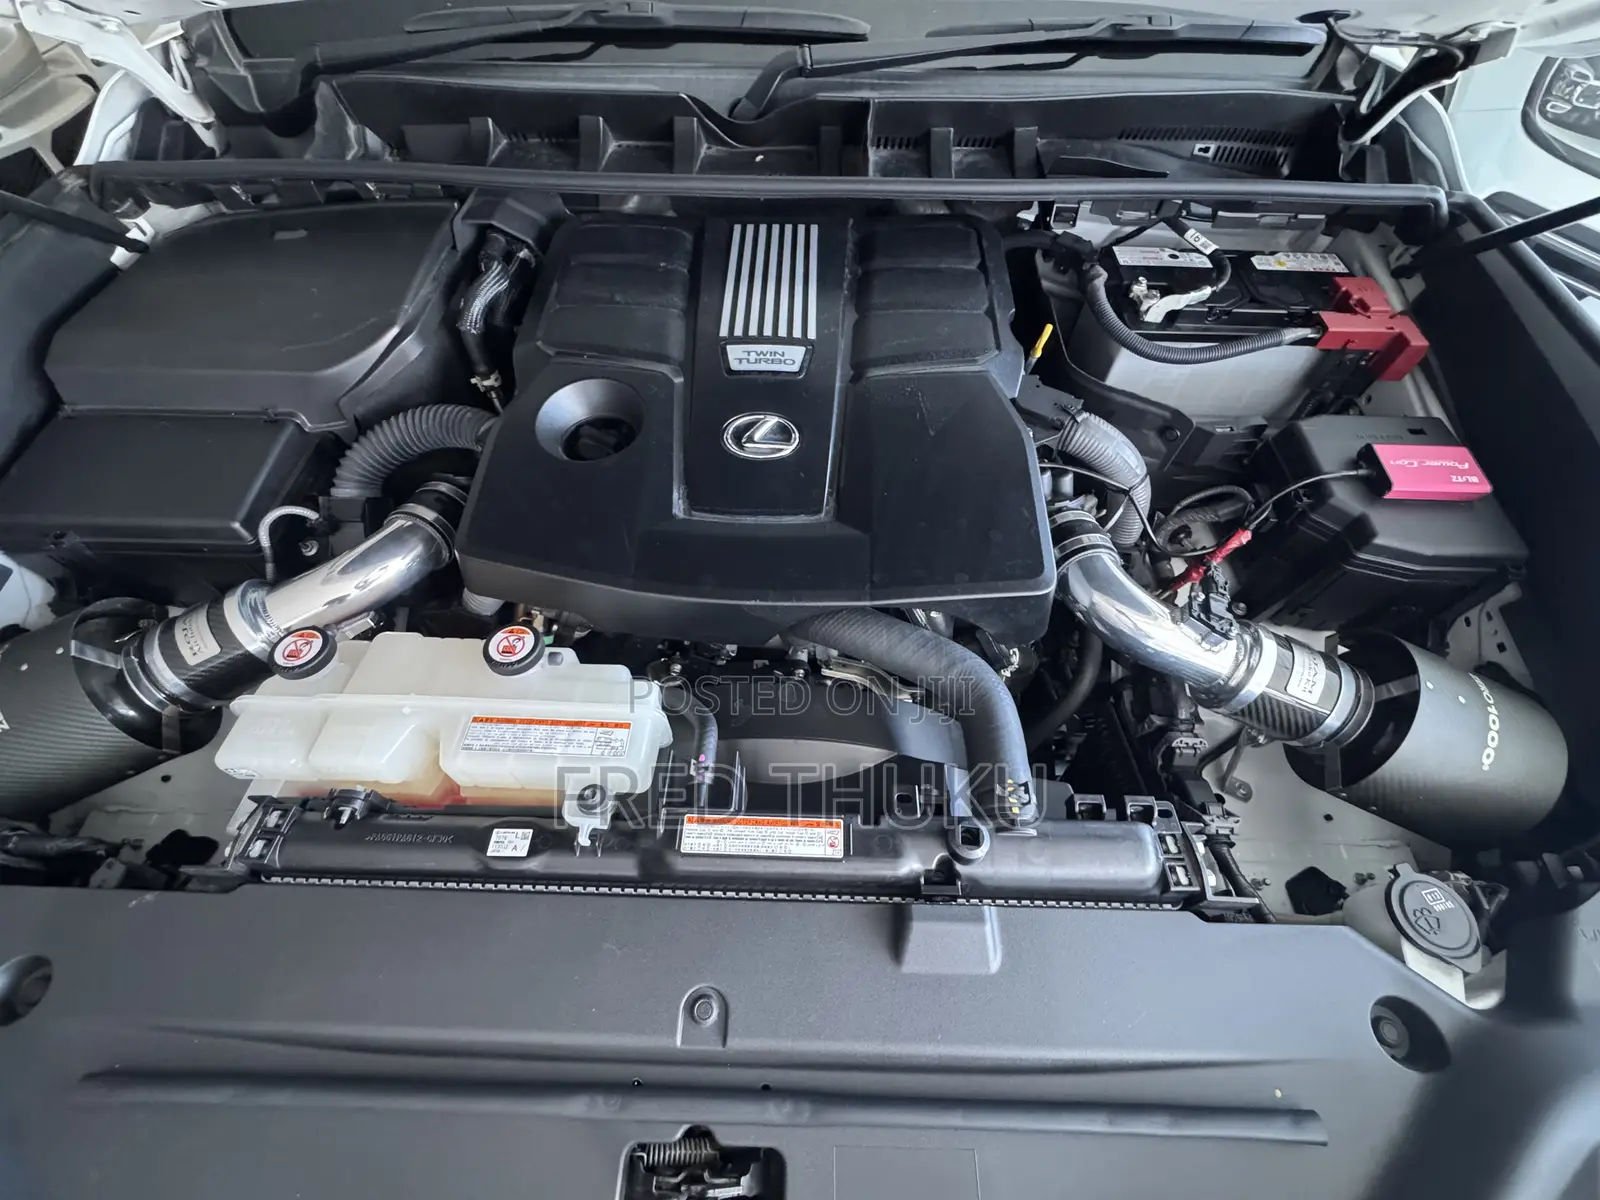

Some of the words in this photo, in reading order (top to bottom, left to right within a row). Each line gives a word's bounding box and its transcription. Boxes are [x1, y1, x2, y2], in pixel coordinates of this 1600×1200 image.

[742, 350, 785, 358] TWIN
[734, 357, 796, 366] TURBO
[1389, 459, 1418, 468] Con
[1421, 459, 1469, 470] Power
[1450, 475, 1480, 483] BLITZ
